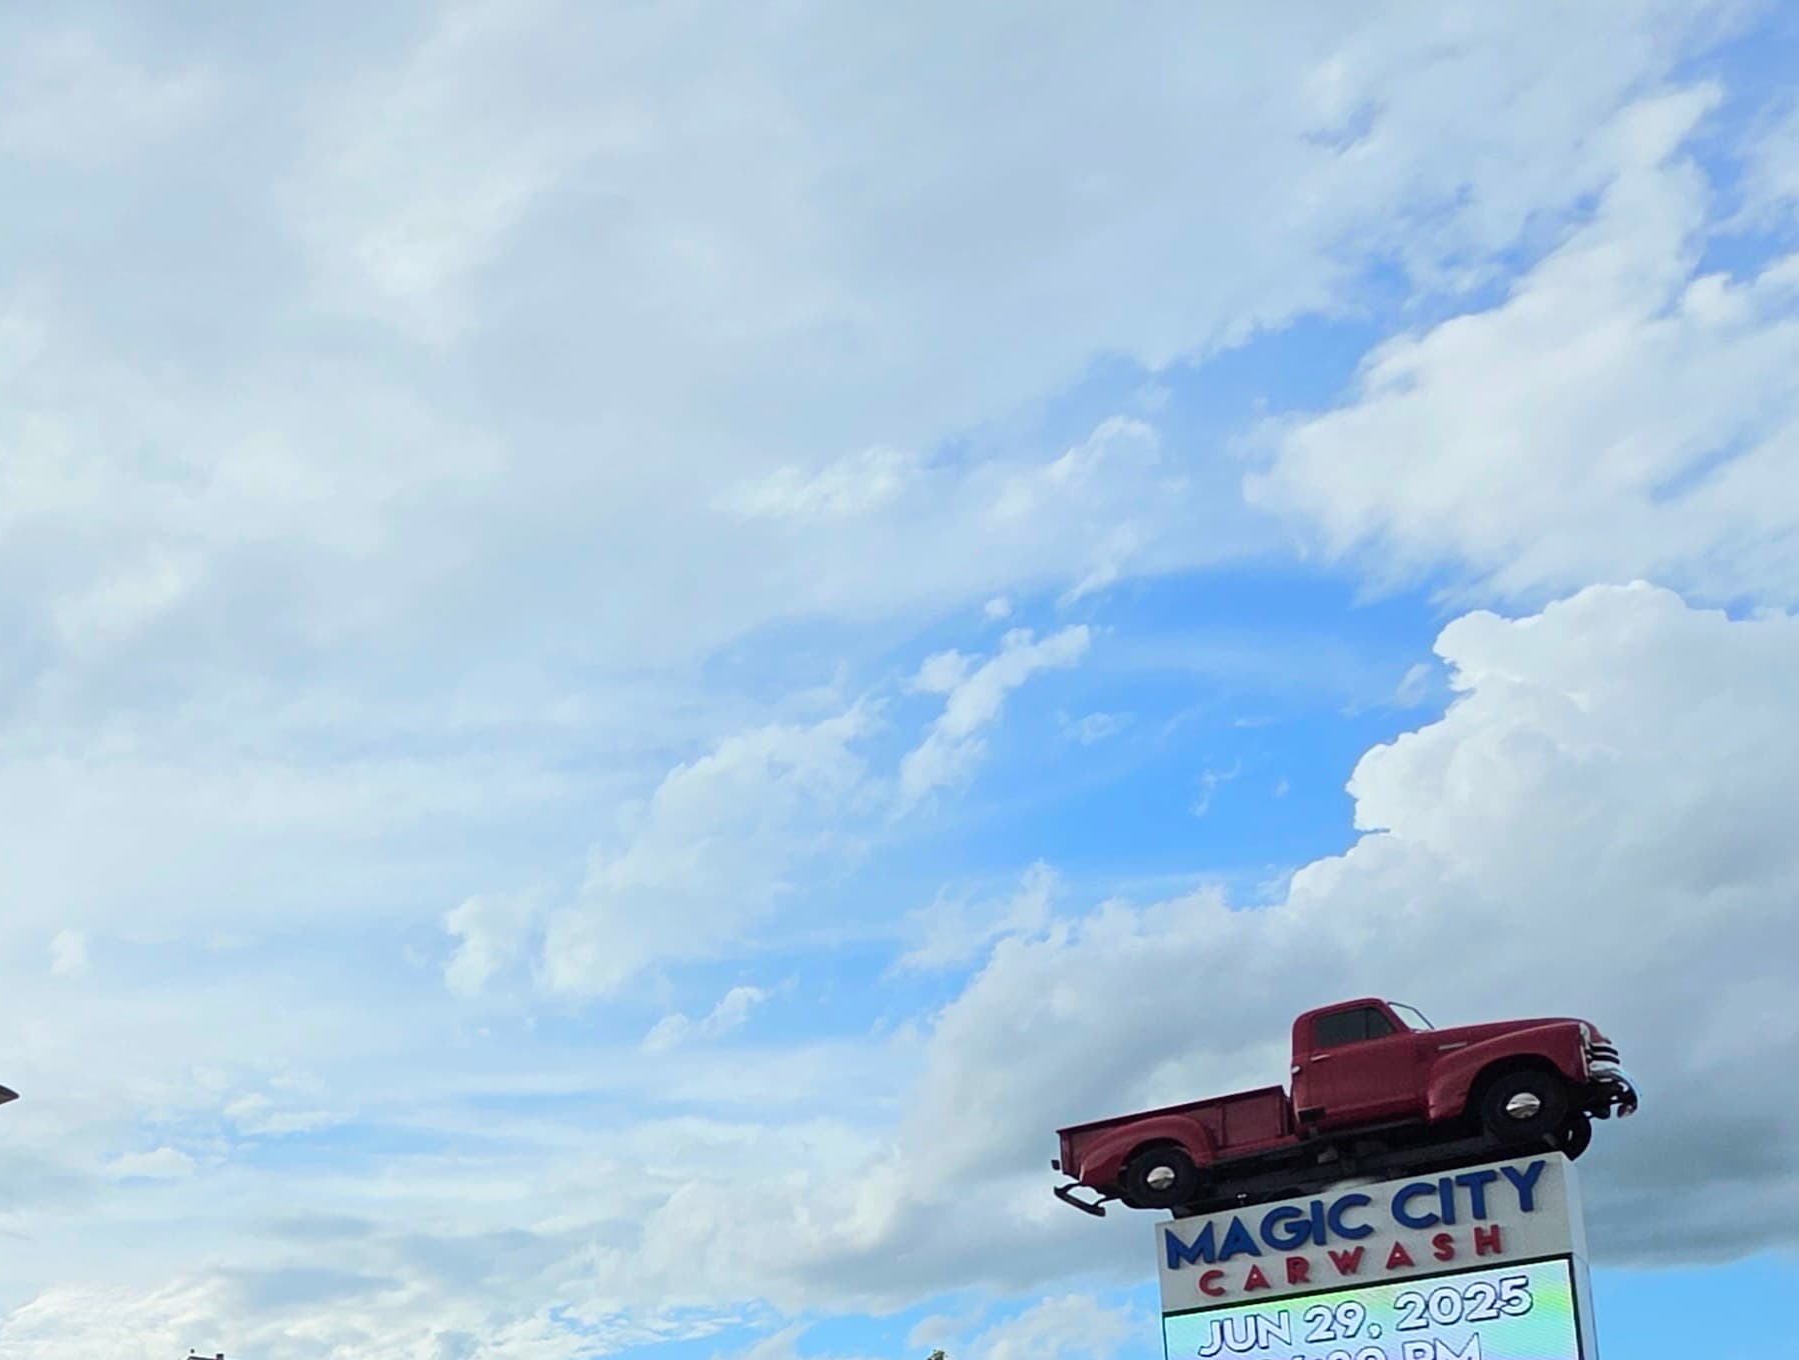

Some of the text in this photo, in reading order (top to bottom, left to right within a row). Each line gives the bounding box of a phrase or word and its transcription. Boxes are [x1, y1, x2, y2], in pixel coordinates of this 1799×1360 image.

[1164, 1160, 1546, 1270] MAGIC CITY
[1198, 1224, 1505, 1296] CARWASH
[1198, 1275, 1534, 1357] JUN 29, 2025
